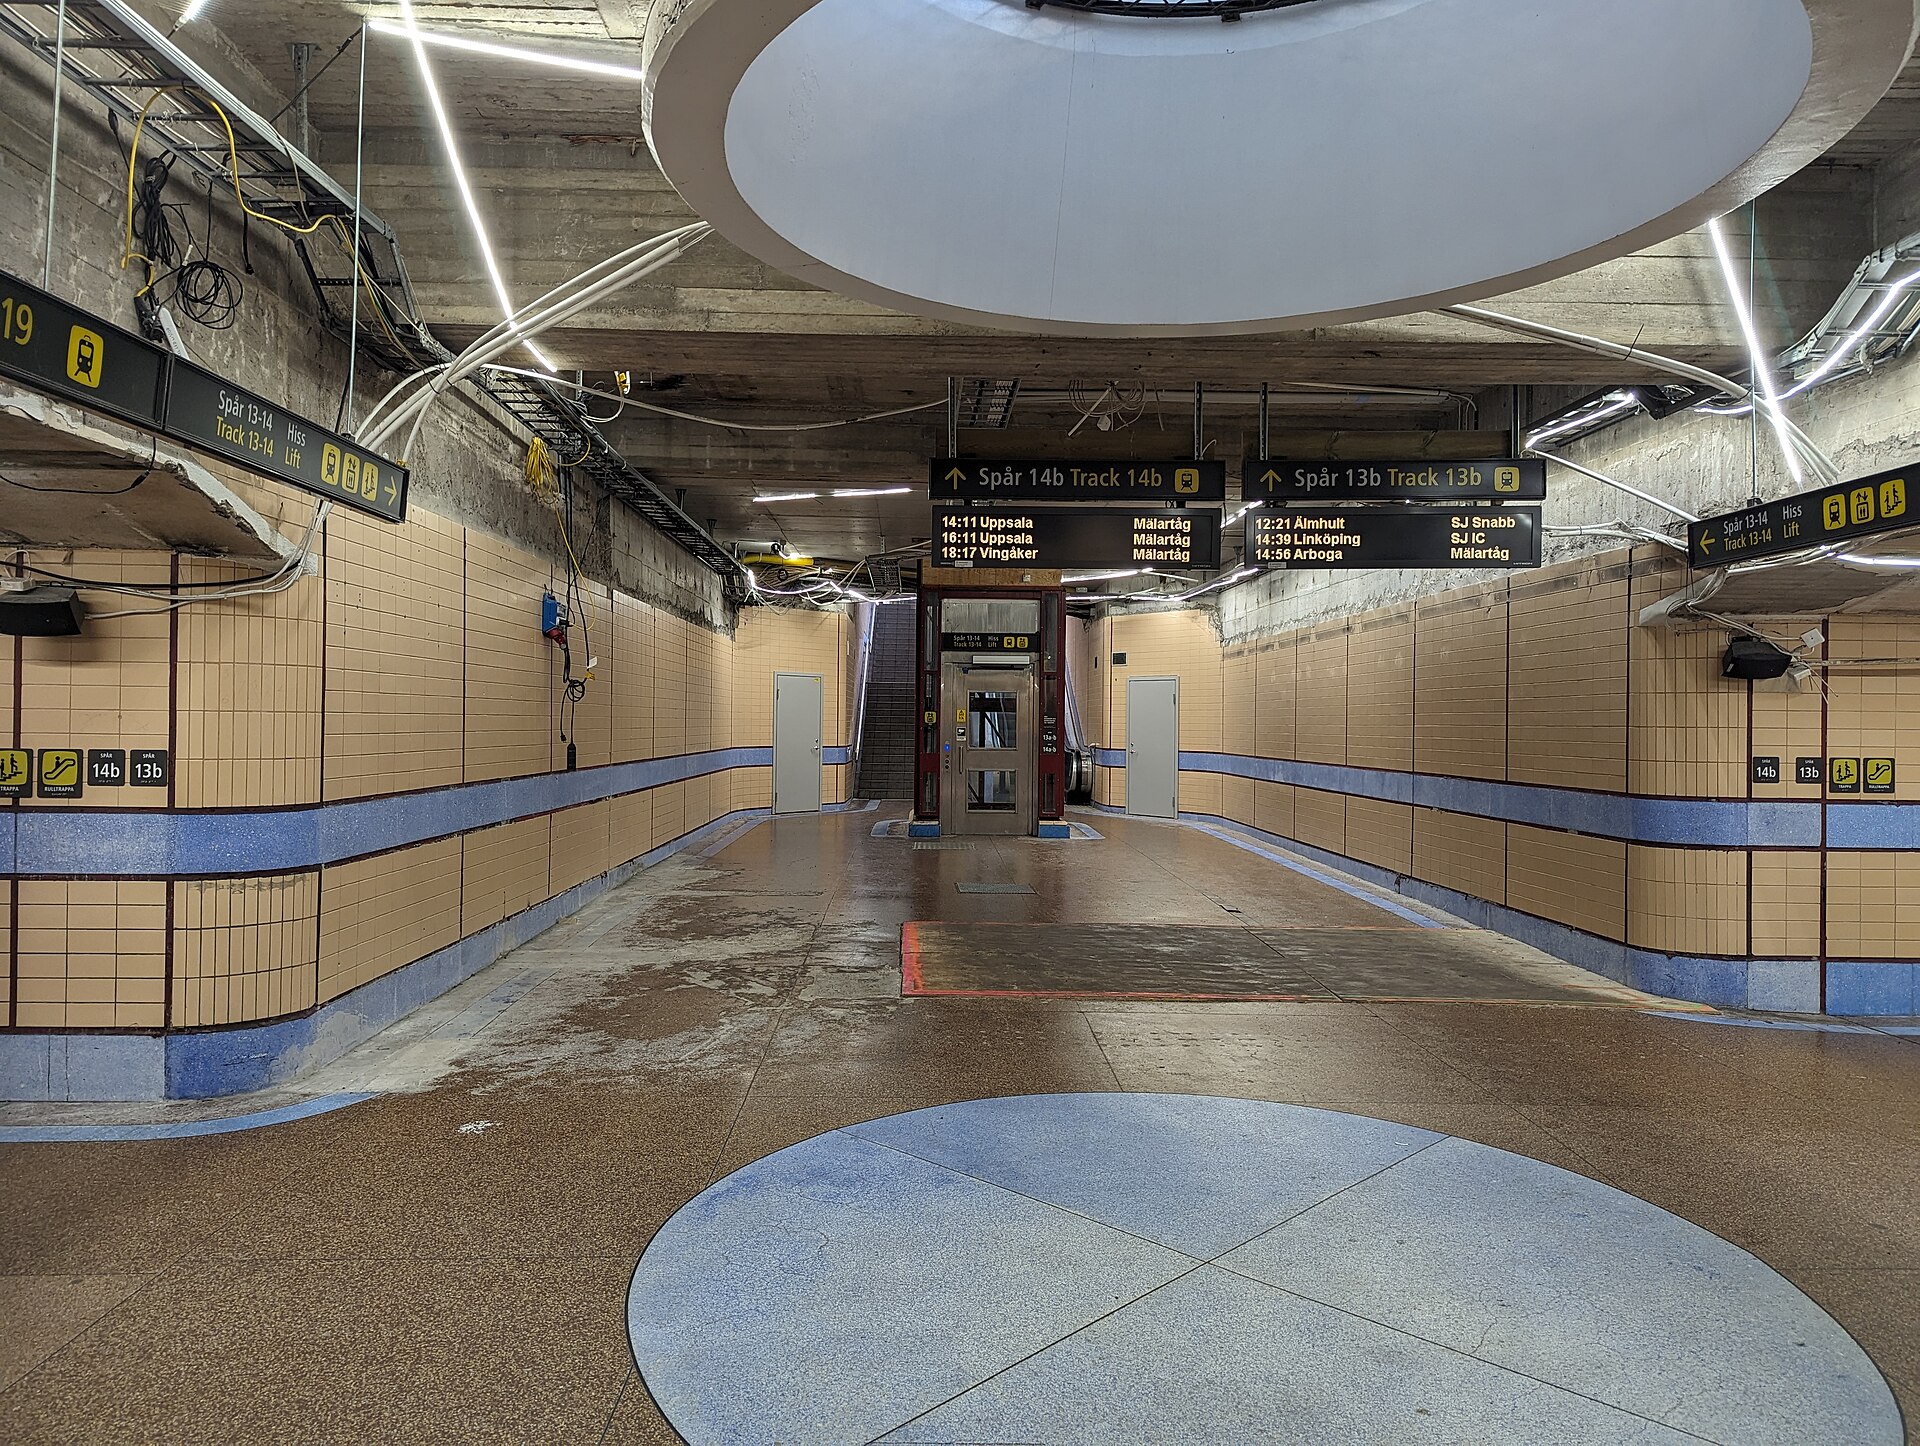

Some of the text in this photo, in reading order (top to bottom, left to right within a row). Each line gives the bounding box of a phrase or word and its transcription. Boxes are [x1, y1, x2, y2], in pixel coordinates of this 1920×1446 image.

[2, 298, 33, 345] 19
[218, 389, 273, 432] Spår 13-14
[216, 415, 274, 458] Track 13-14
[287, 422, 306, 447] Hiss
[284, 446, 301, 469] Lift
[979, 466, 1163, 492] Spår 14b Track 14b
[1294, 466, 1482, 492] Spår 13b Track 13b
[1782, 504, 1802, 520] Hiss
[942, 516, 1192, 533] 14:11 Uppsala Mälartåg
[1256, 516, 1516, 530] 12:21 Älmhult SJ Snabb
[1723, 511, 1769, 537] Spår 13-14
[1783, 521, 1800, 539] Lift
[942, 532, 1191, 547] 16:11 Uppsala Mälartåg
[1256, 533, 1486, 547] 14:39 Linköping SJ IC
[1724, 528, 1773, 552] Track 13-14
[941, 546, 1190, 562] 18:17 Vingåker Mälartåg
[1255, 546, 1510, 562] 14:56 Arboga Mälartåg
[92, 763, 120, 778] 14b
[135, 763, 163, 779] 13b
[1756, 766, 1777, 779] 14b
[1799, 767, 1820, 779] 13b
